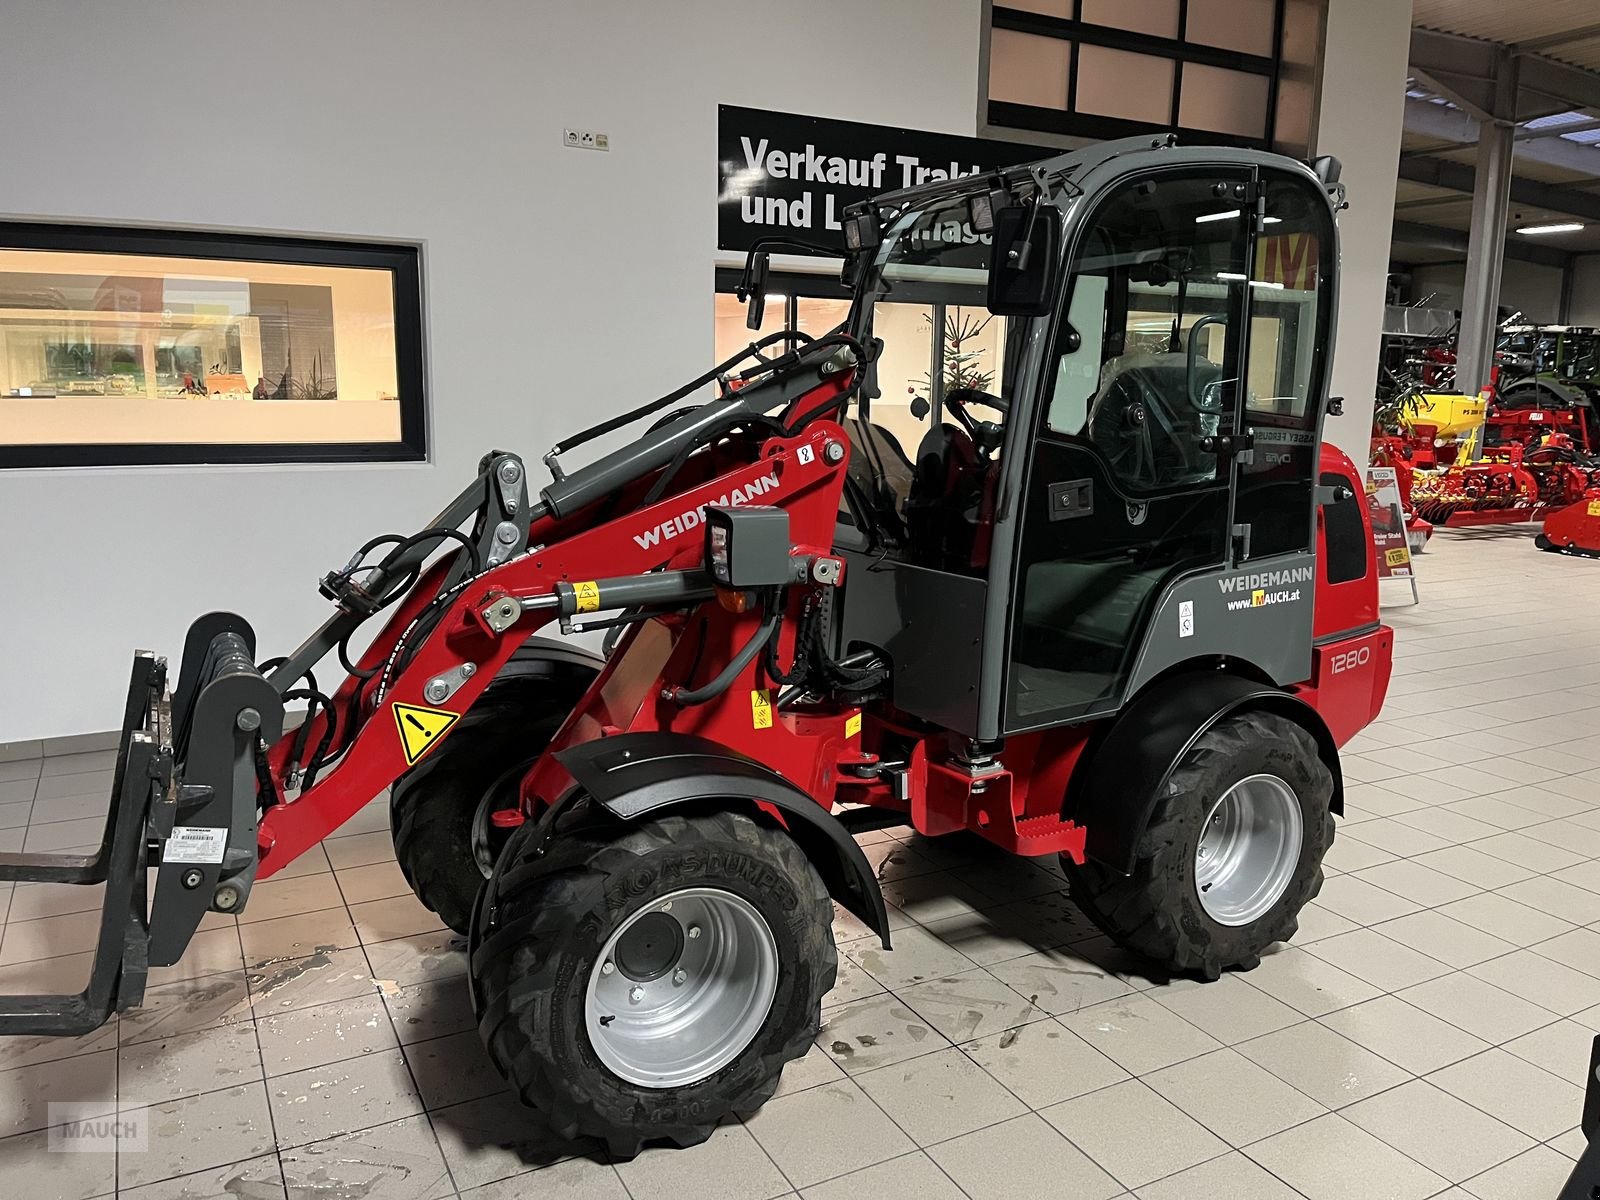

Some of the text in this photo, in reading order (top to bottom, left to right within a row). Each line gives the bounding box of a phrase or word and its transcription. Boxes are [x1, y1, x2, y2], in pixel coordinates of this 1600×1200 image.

[741, 136, 886, 188] Verkauf
[741, 192, 812, 229] und
[1218, 567, 1313, 593] WEIDEMANN
[1227, 589, 1301, 611] www.MAUCH.at
[1330, 647, 1370, 675] 1280
